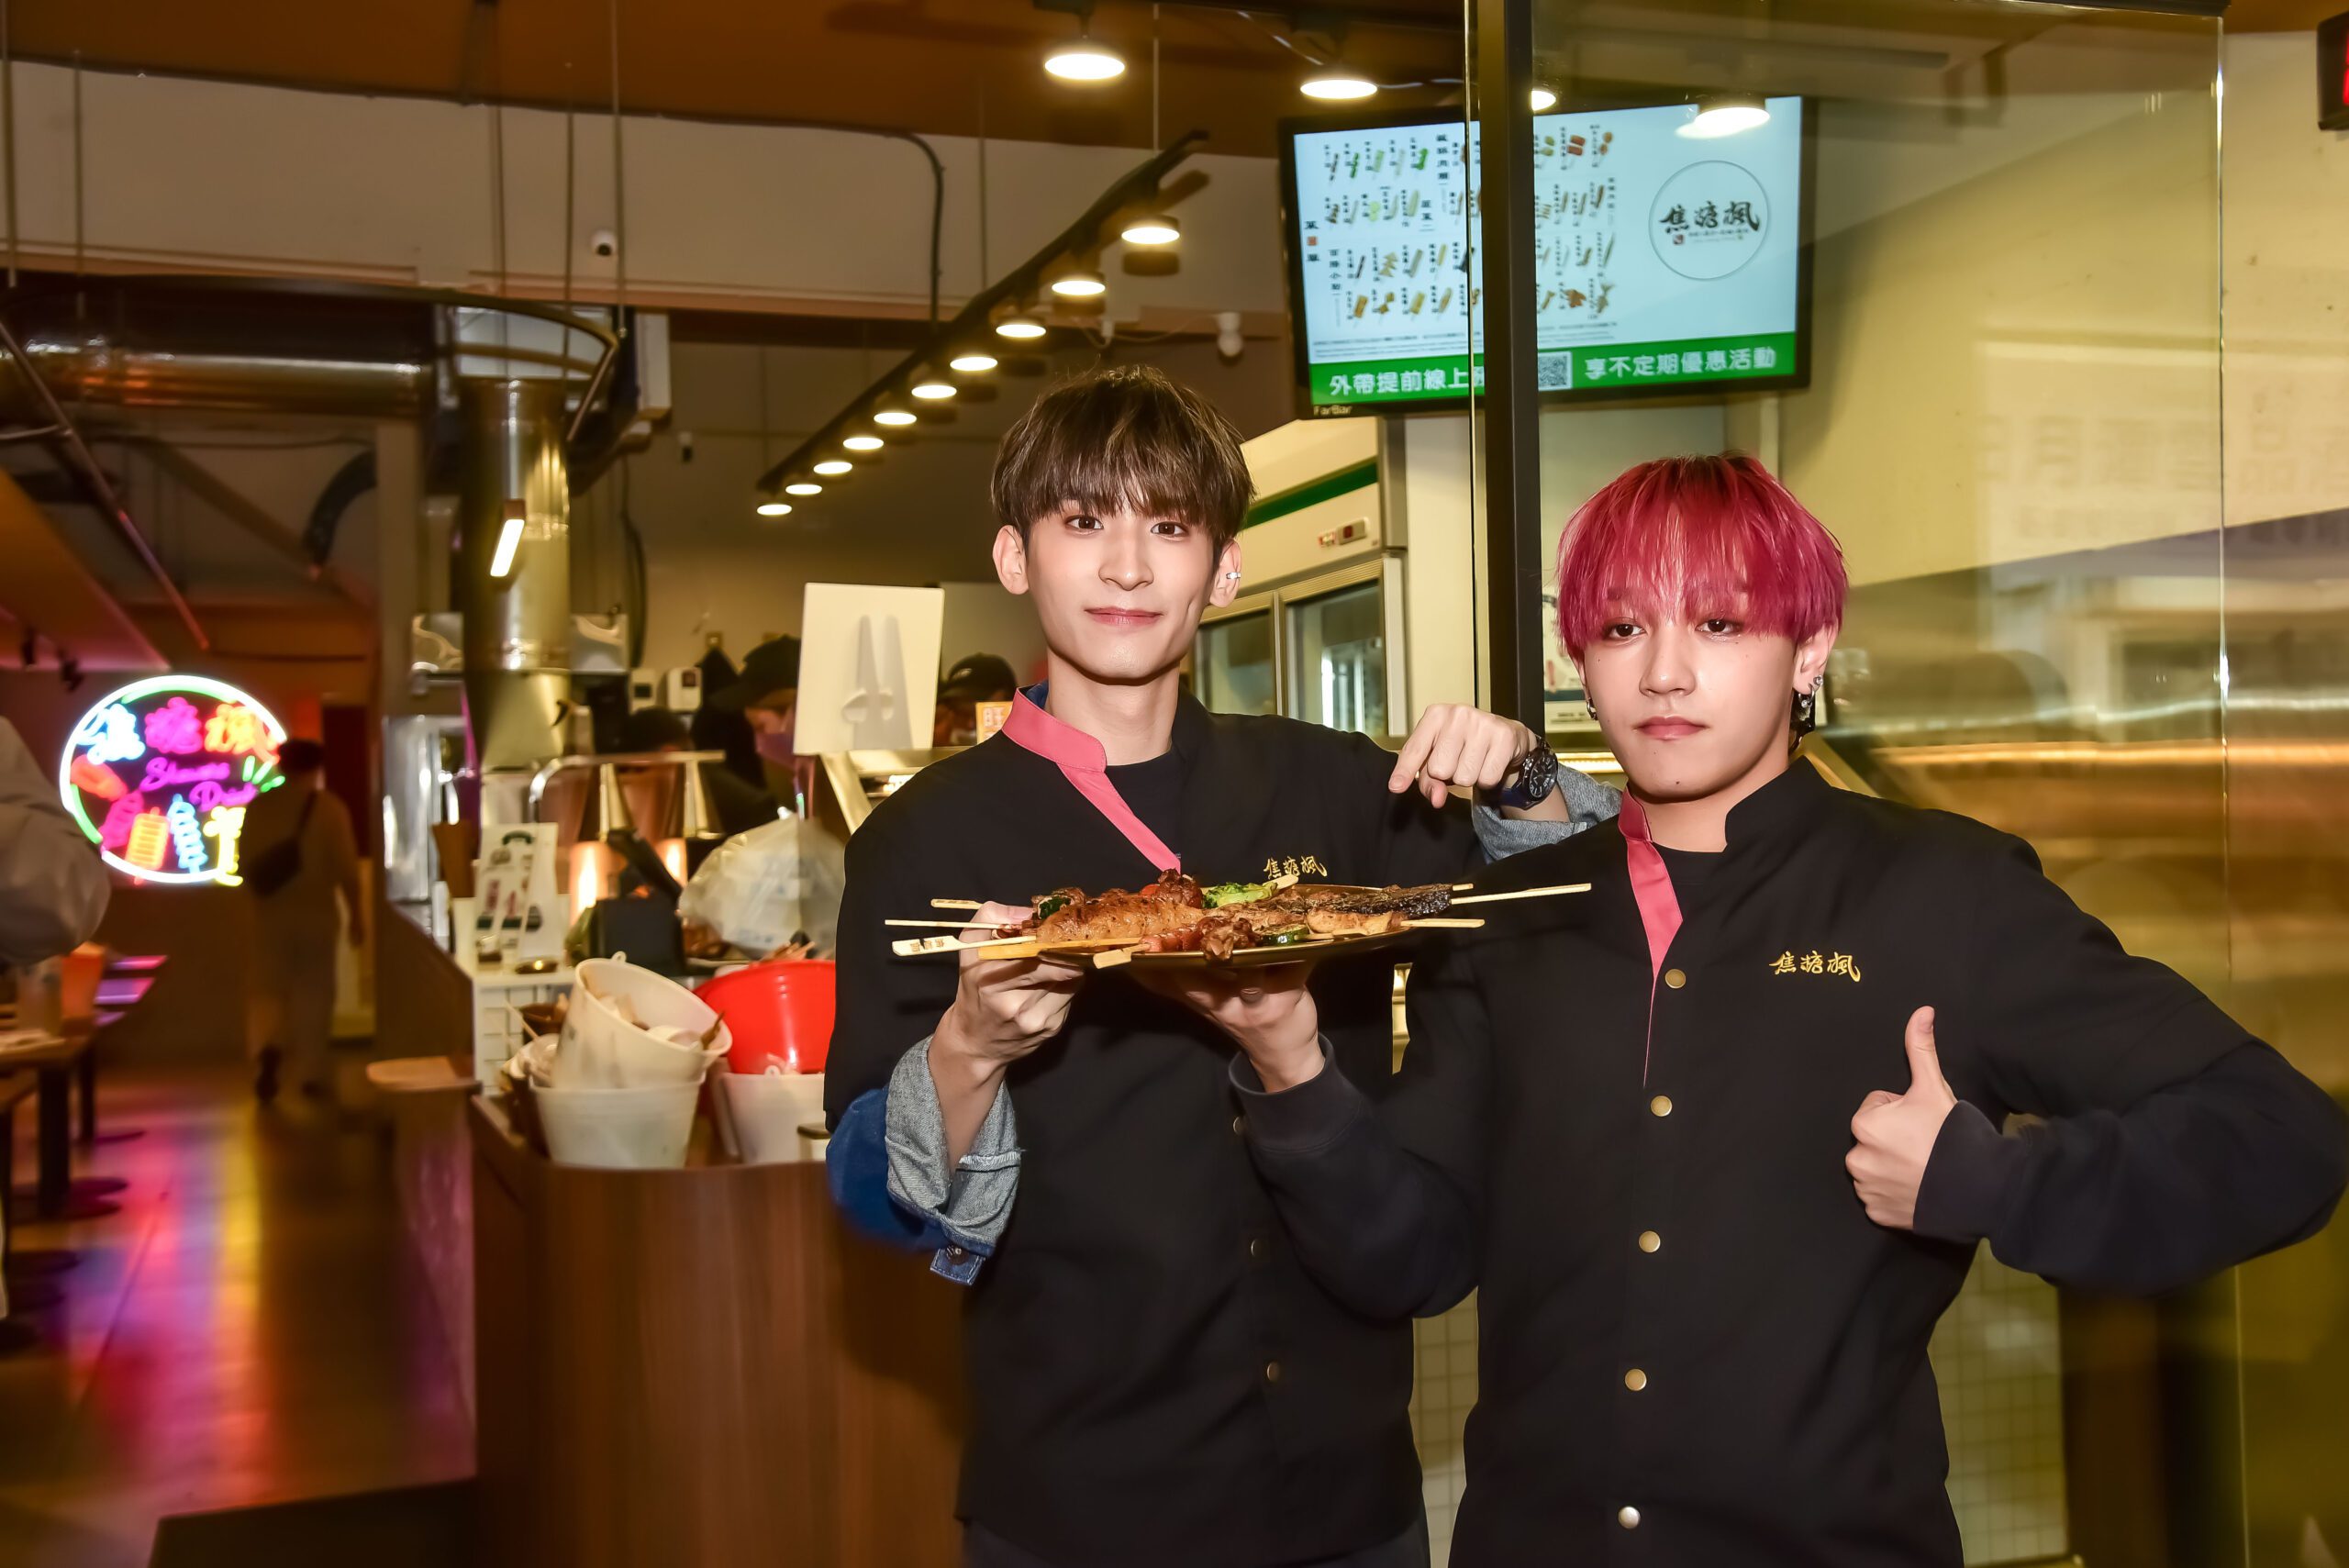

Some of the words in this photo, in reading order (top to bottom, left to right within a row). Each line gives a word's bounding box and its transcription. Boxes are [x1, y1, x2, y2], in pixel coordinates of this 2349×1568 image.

[1585, 346, 1777, 380] 享不定期優惠活動
[1264, 855, 1328, 880] 焦糖楓
[1769, 951, 1861, 982] 焦糖楓
